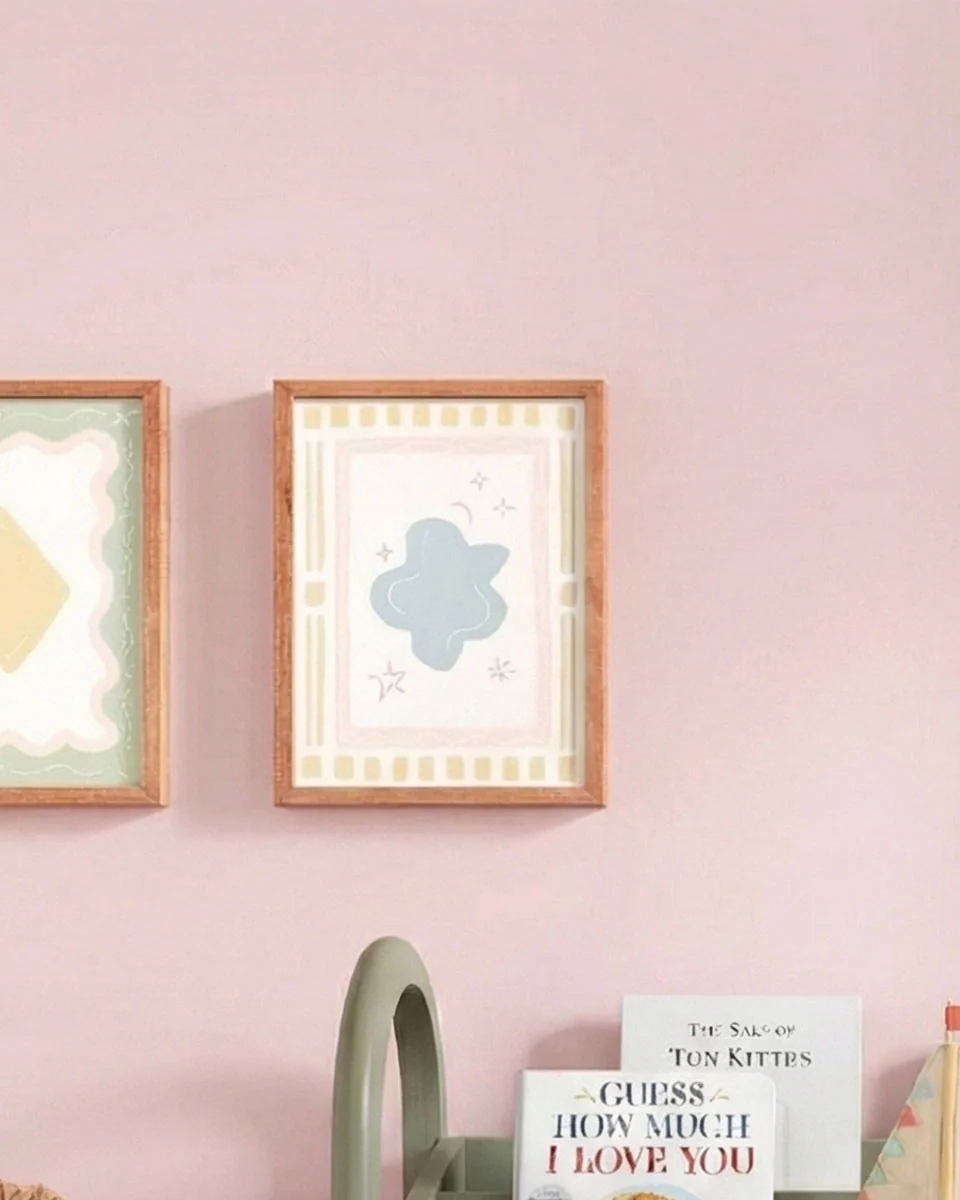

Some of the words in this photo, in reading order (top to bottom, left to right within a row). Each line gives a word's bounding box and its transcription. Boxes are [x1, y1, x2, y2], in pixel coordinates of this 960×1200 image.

[599, 1081, 705, 1106] GUESS
[553, 1113, 634, 1139] HOW
[645, 1113, 751, 1139] MUCH
[546, 1145, 557, 1174] I
[574, 1146, 668, 1175] LOVE
[680, 1146, 754, 1175] YOU
